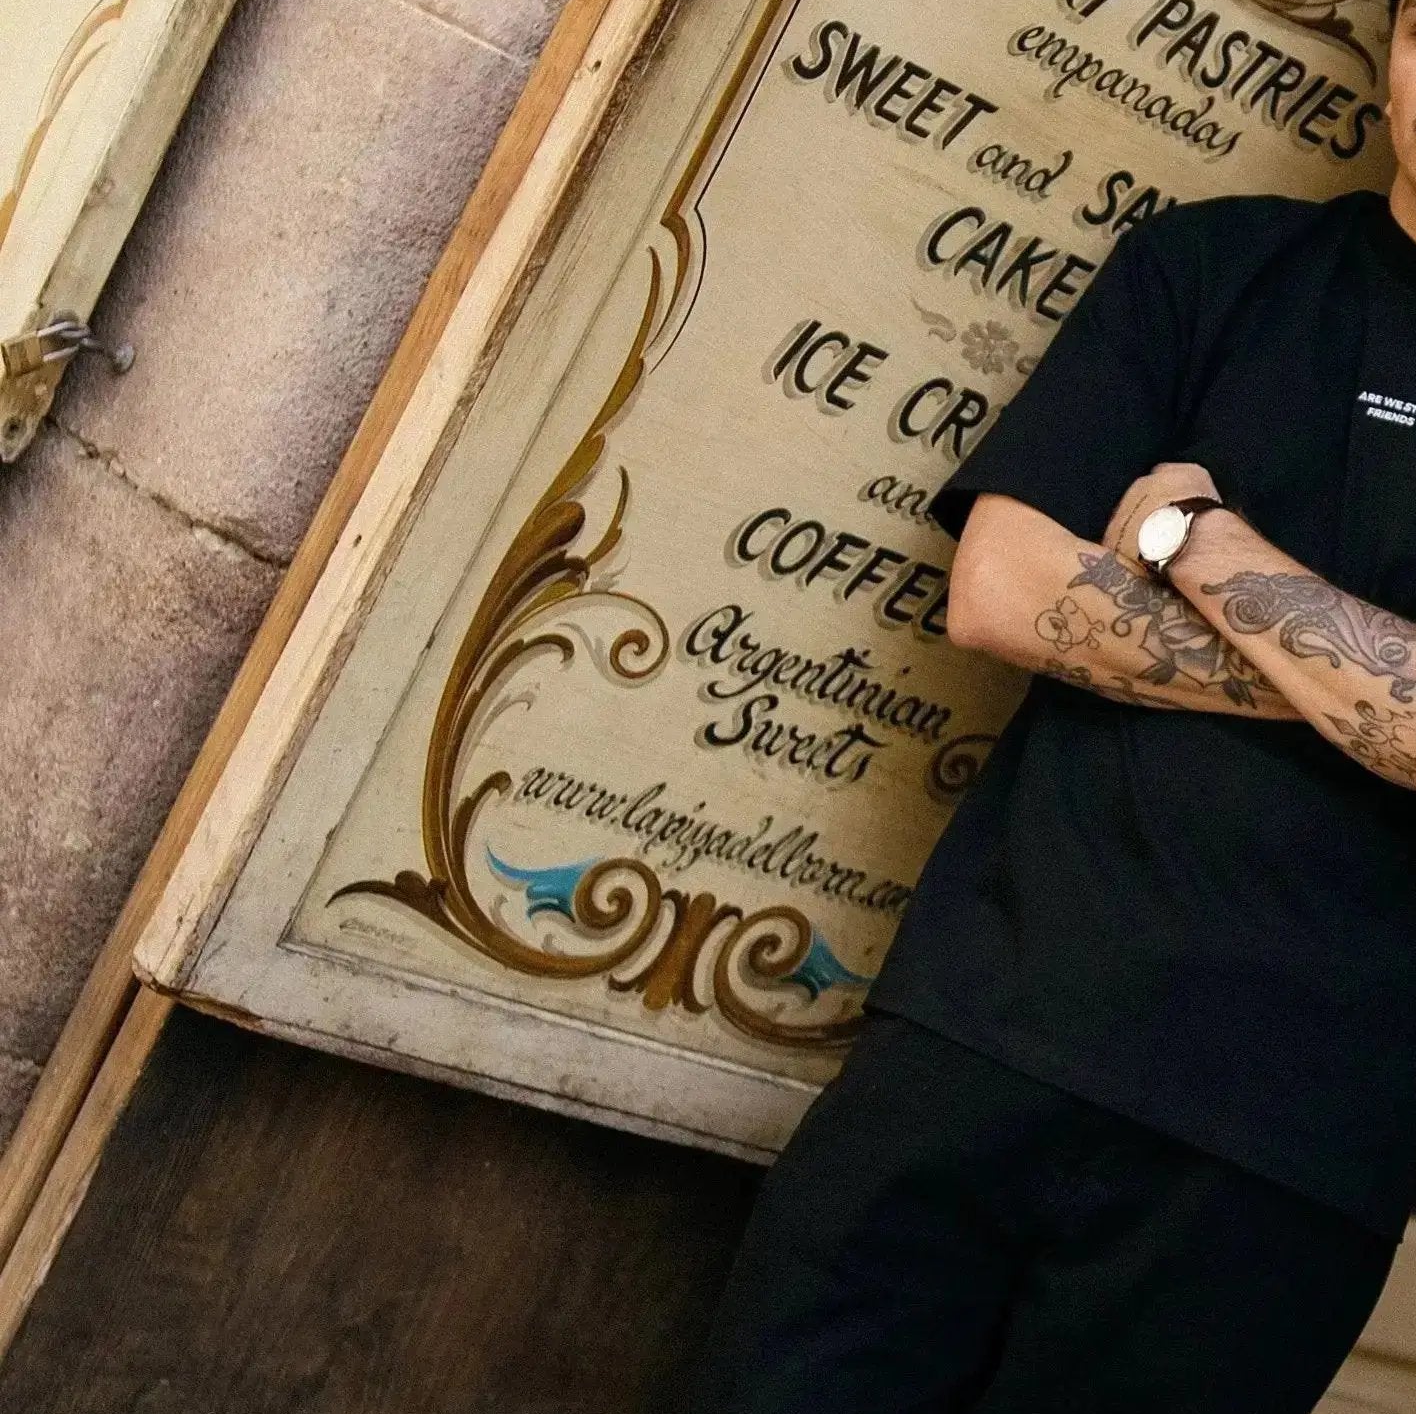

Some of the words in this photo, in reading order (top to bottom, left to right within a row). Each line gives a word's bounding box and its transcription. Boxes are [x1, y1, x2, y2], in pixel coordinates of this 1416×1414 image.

[790, 19, 1000, 152] SWEET
[974, 147, 1074, 201] and
[1079, 169, 1178, 236] SA
[1013, 23, 1242, 160] empanadas
[771, 318, 890, 412] ICE
[897, 376, 991, 460] CR
[1358, 391, 1383, 404] ARE
[1384, 397, 1404, 410] WE
[1366, 407, 1415, 426] FRIENDS
[865, 474, 936, 524] an
[683, 603, 954, 738] Argentinian
[701, 693, 887, 784] Sweets
